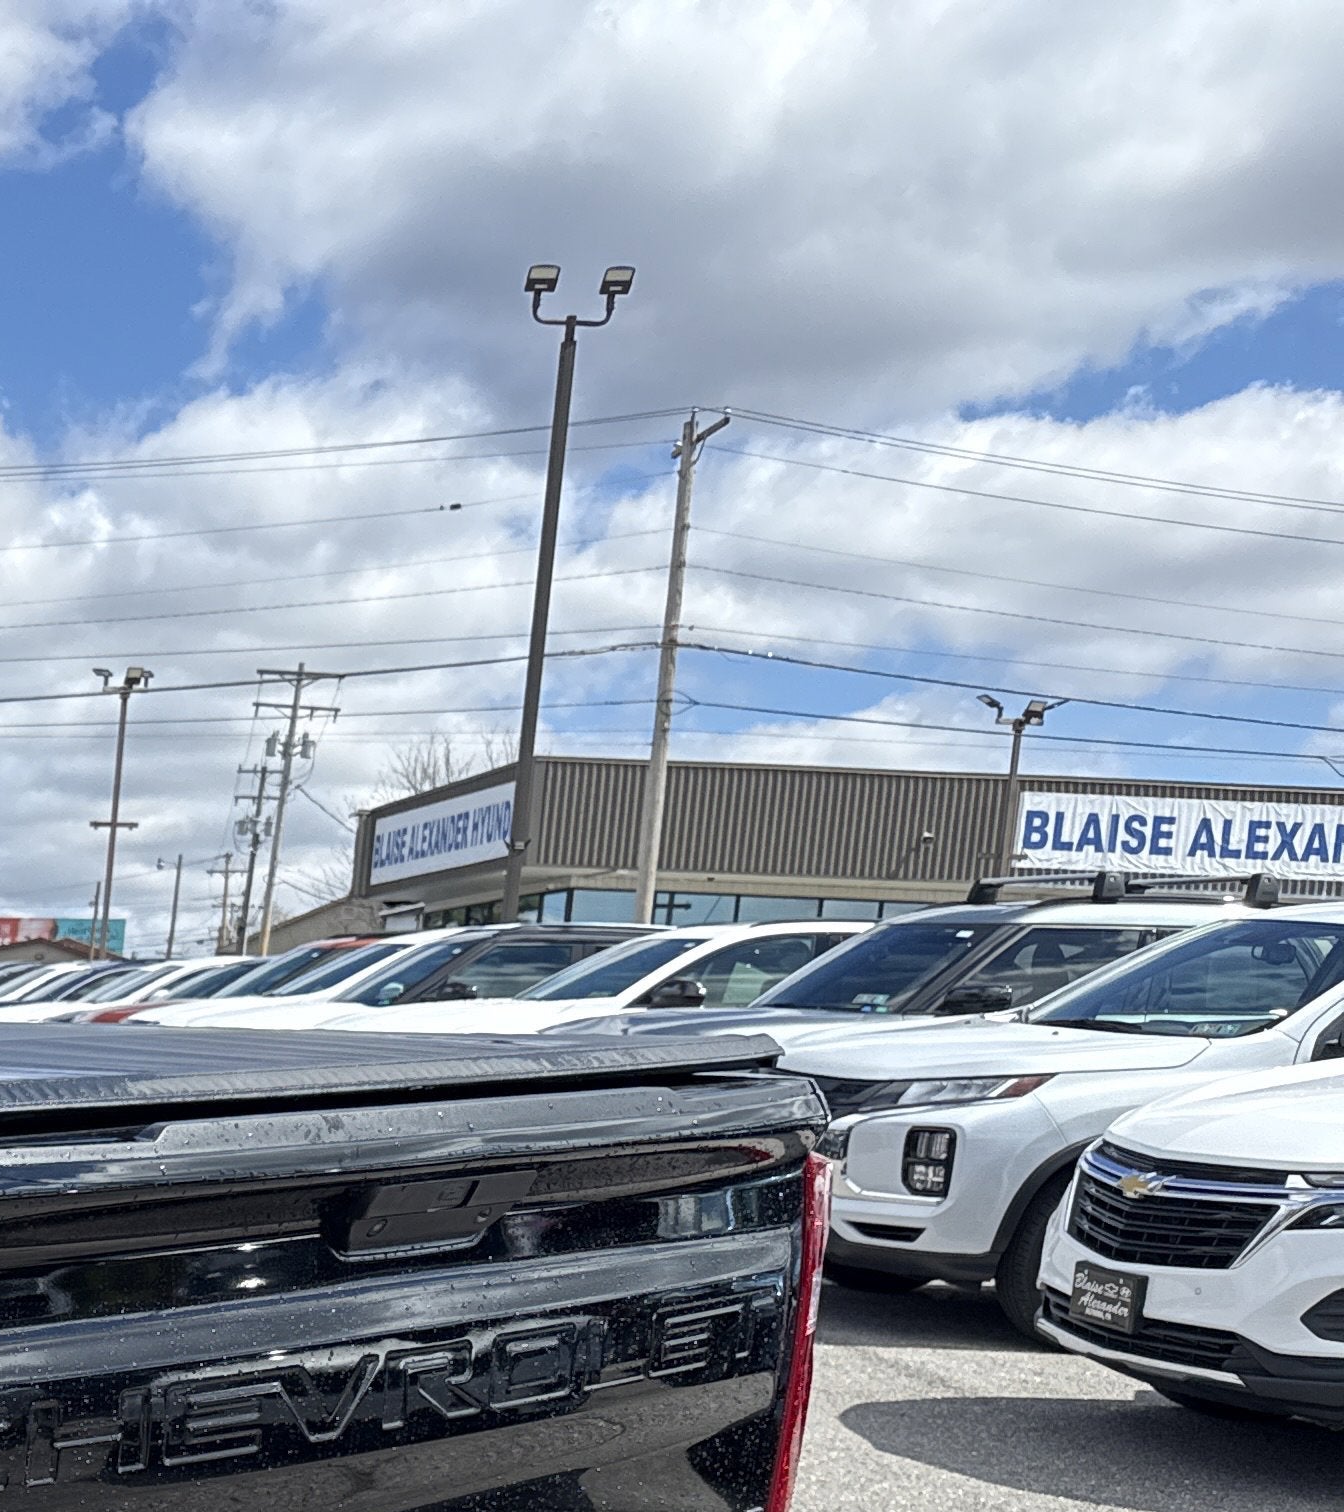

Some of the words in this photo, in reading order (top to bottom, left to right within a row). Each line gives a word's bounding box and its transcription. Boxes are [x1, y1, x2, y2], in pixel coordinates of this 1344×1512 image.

[373, 827, 408, 869] BLAISE
[407, 811, 470, 862] ALEXANDER
[470, 800, 511, 848] HYUND
[1022, 809, 1176, 856] BLAISE
